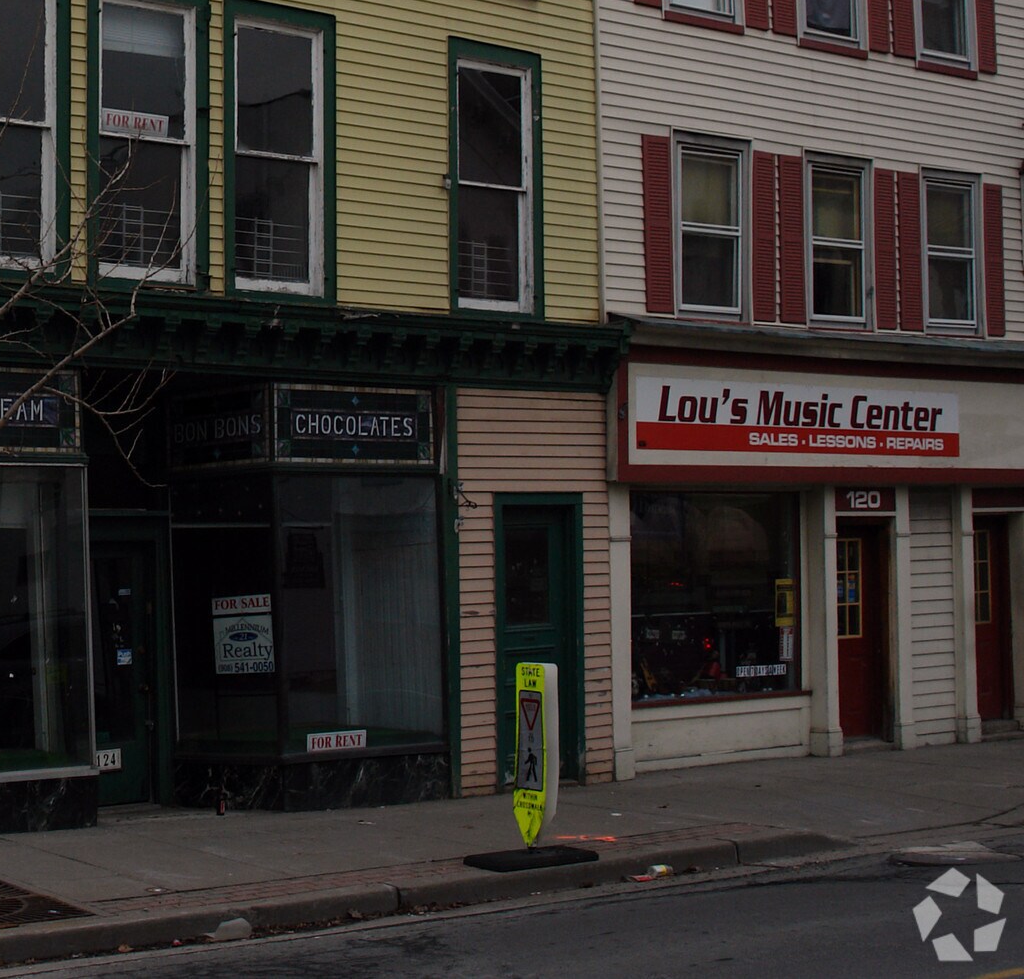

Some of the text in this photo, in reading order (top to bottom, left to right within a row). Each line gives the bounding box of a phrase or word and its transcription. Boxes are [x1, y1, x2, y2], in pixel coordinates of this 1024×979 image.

[106, 113, 164, 132] FOR RENT
[658, 385, 943, 432] Lou's Music Center
[174, 413, 262, 443] BON BONS
[295, 413, 413, 437] CHOCOLATES
[749, 432, 944, 451] SALES LESSONS REPAIRS
[846, 490, 881, 509] 120
[214, 596, 270, 610] FOR SALE
[222, 642, 273, 661] Realty
[234, 660, 274, 672] 541-0050
[521, 666, 540, 677] STATE
[524, 678, 537, 688] LAW
[311, 733, 362, 750] FOR RENT
[96, 753, 116, 767] 124
